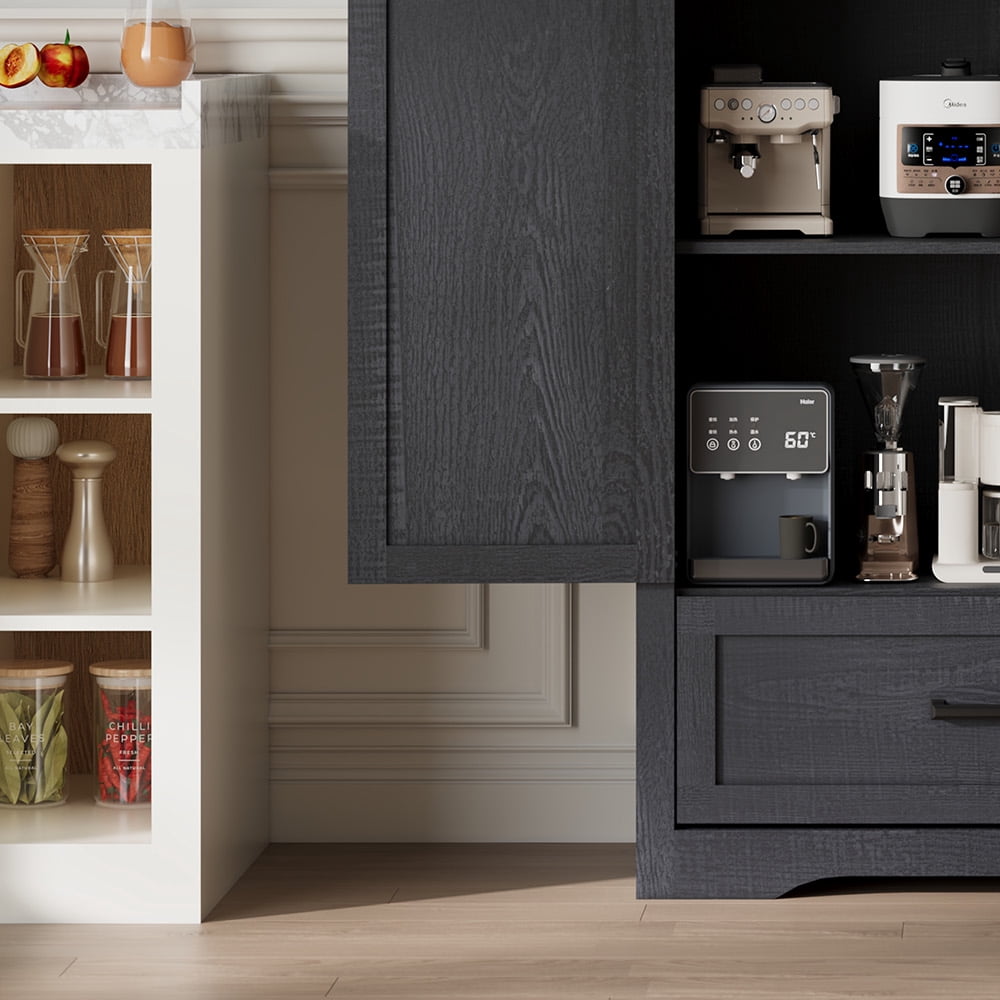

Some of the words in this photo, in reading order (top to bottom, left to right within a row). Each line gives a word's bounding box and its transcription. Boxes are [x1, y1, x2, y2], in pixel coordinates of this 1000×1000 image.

[9, 722, 33, 730] BAY
[109, 721, 150, 731] CHILLI
[4, 734, 45, 743] EAVES
